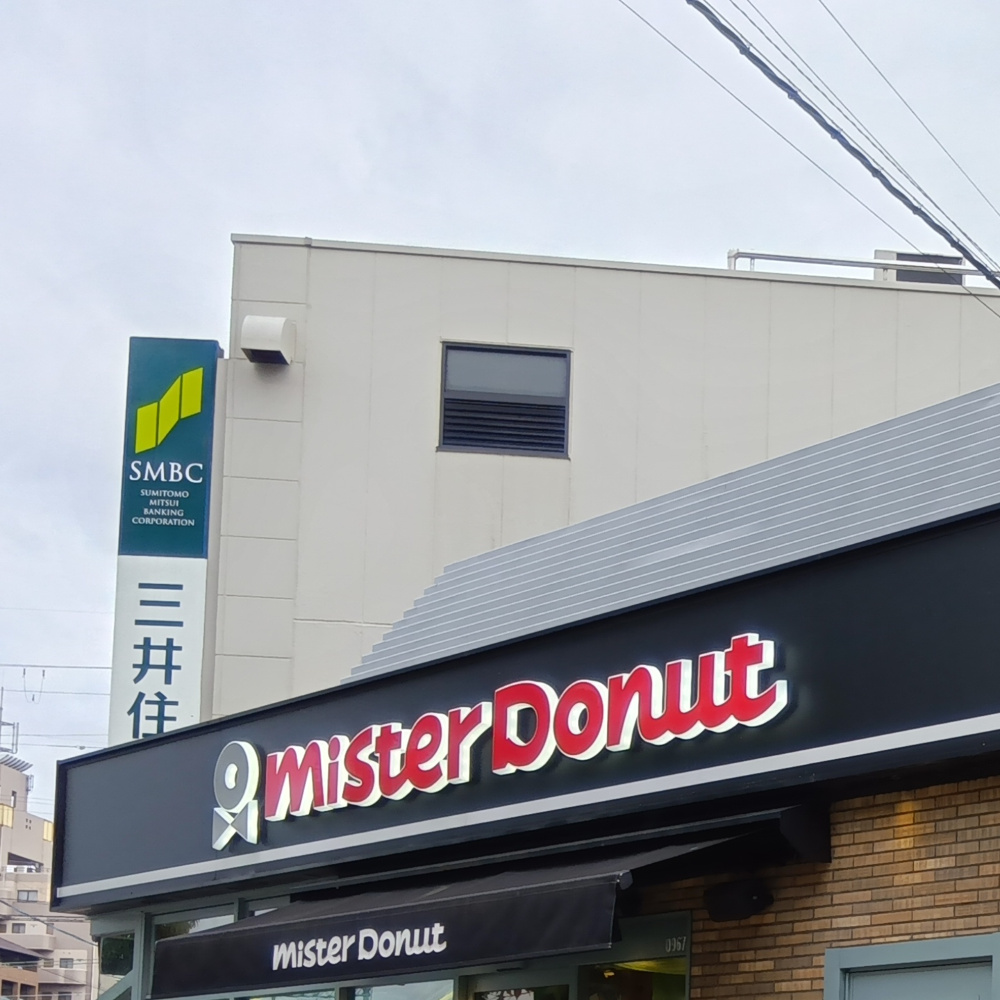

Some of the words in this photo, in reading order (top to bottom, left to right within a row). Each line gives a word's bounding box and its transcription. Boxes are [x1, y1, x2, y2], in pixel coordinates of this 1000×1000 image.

[129, 460, 204, 484] SMBC
[140, 489, 190, 499] SUMITOMO
[149, 499, 180, 507] MITSUI
[143, 508, 185, 517] BANKING
[131, 516, 196, 527] CORPORATION
